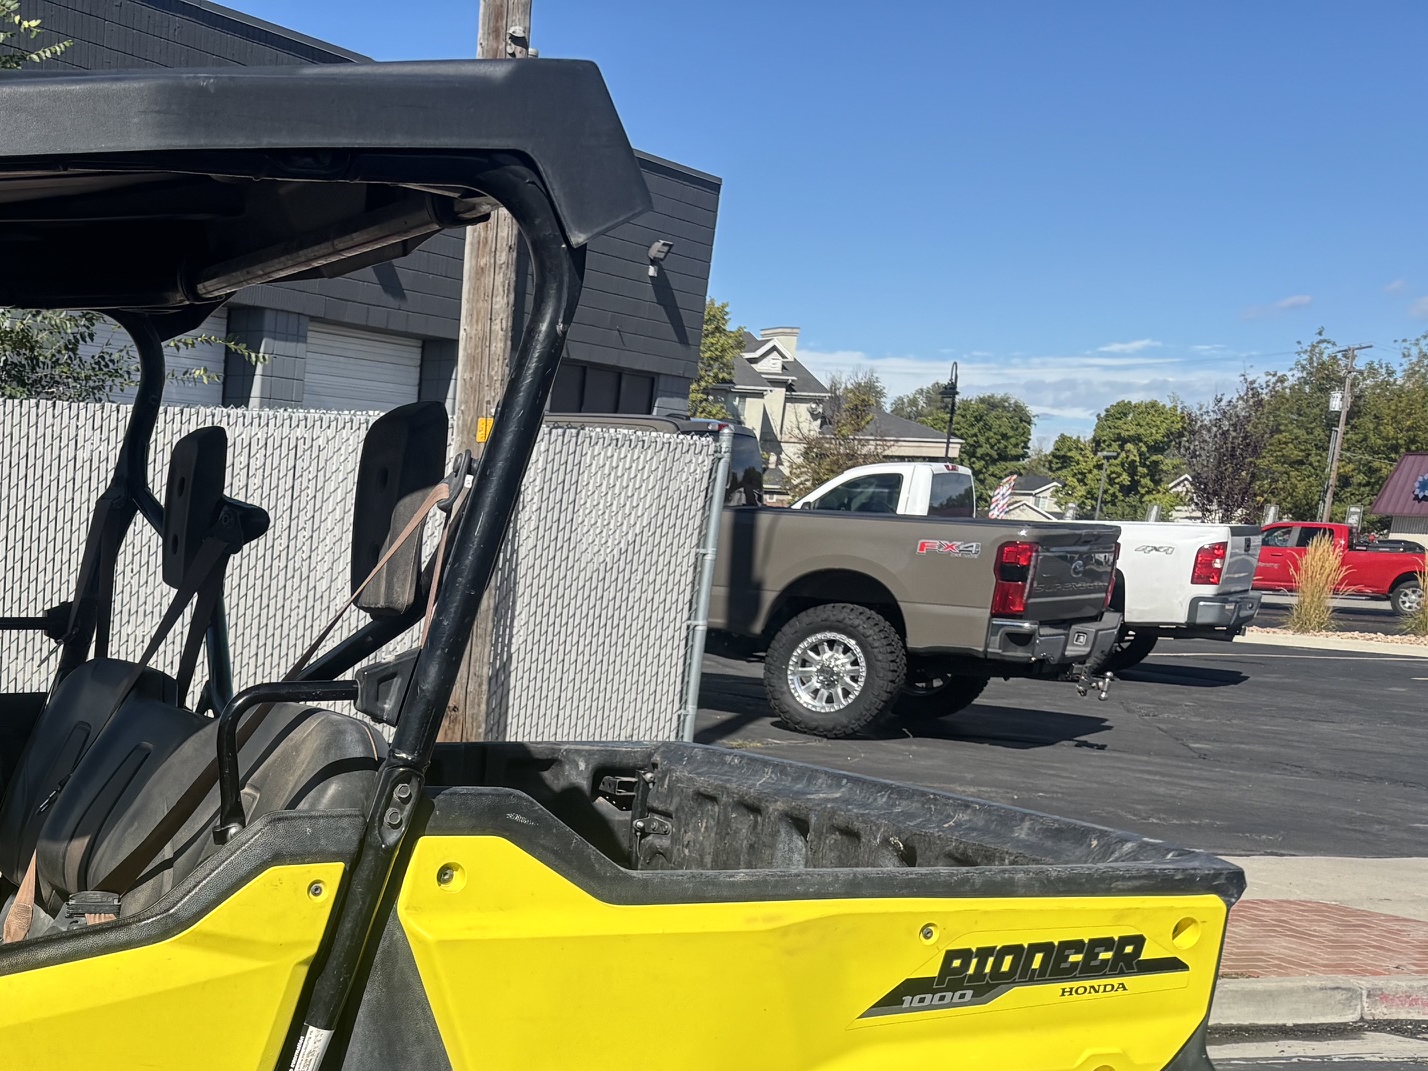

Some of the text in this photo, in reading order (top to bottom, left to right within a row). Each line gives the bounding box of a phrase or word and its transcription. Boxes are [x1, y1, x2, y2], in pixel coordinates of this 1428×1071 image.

[916, 539, 981, 556] FX4
[933, 934, 1148, 988] PIONEER
[901, 989, 974, 1008] 1000
[1059, 982, 1129, 997] HONDA
